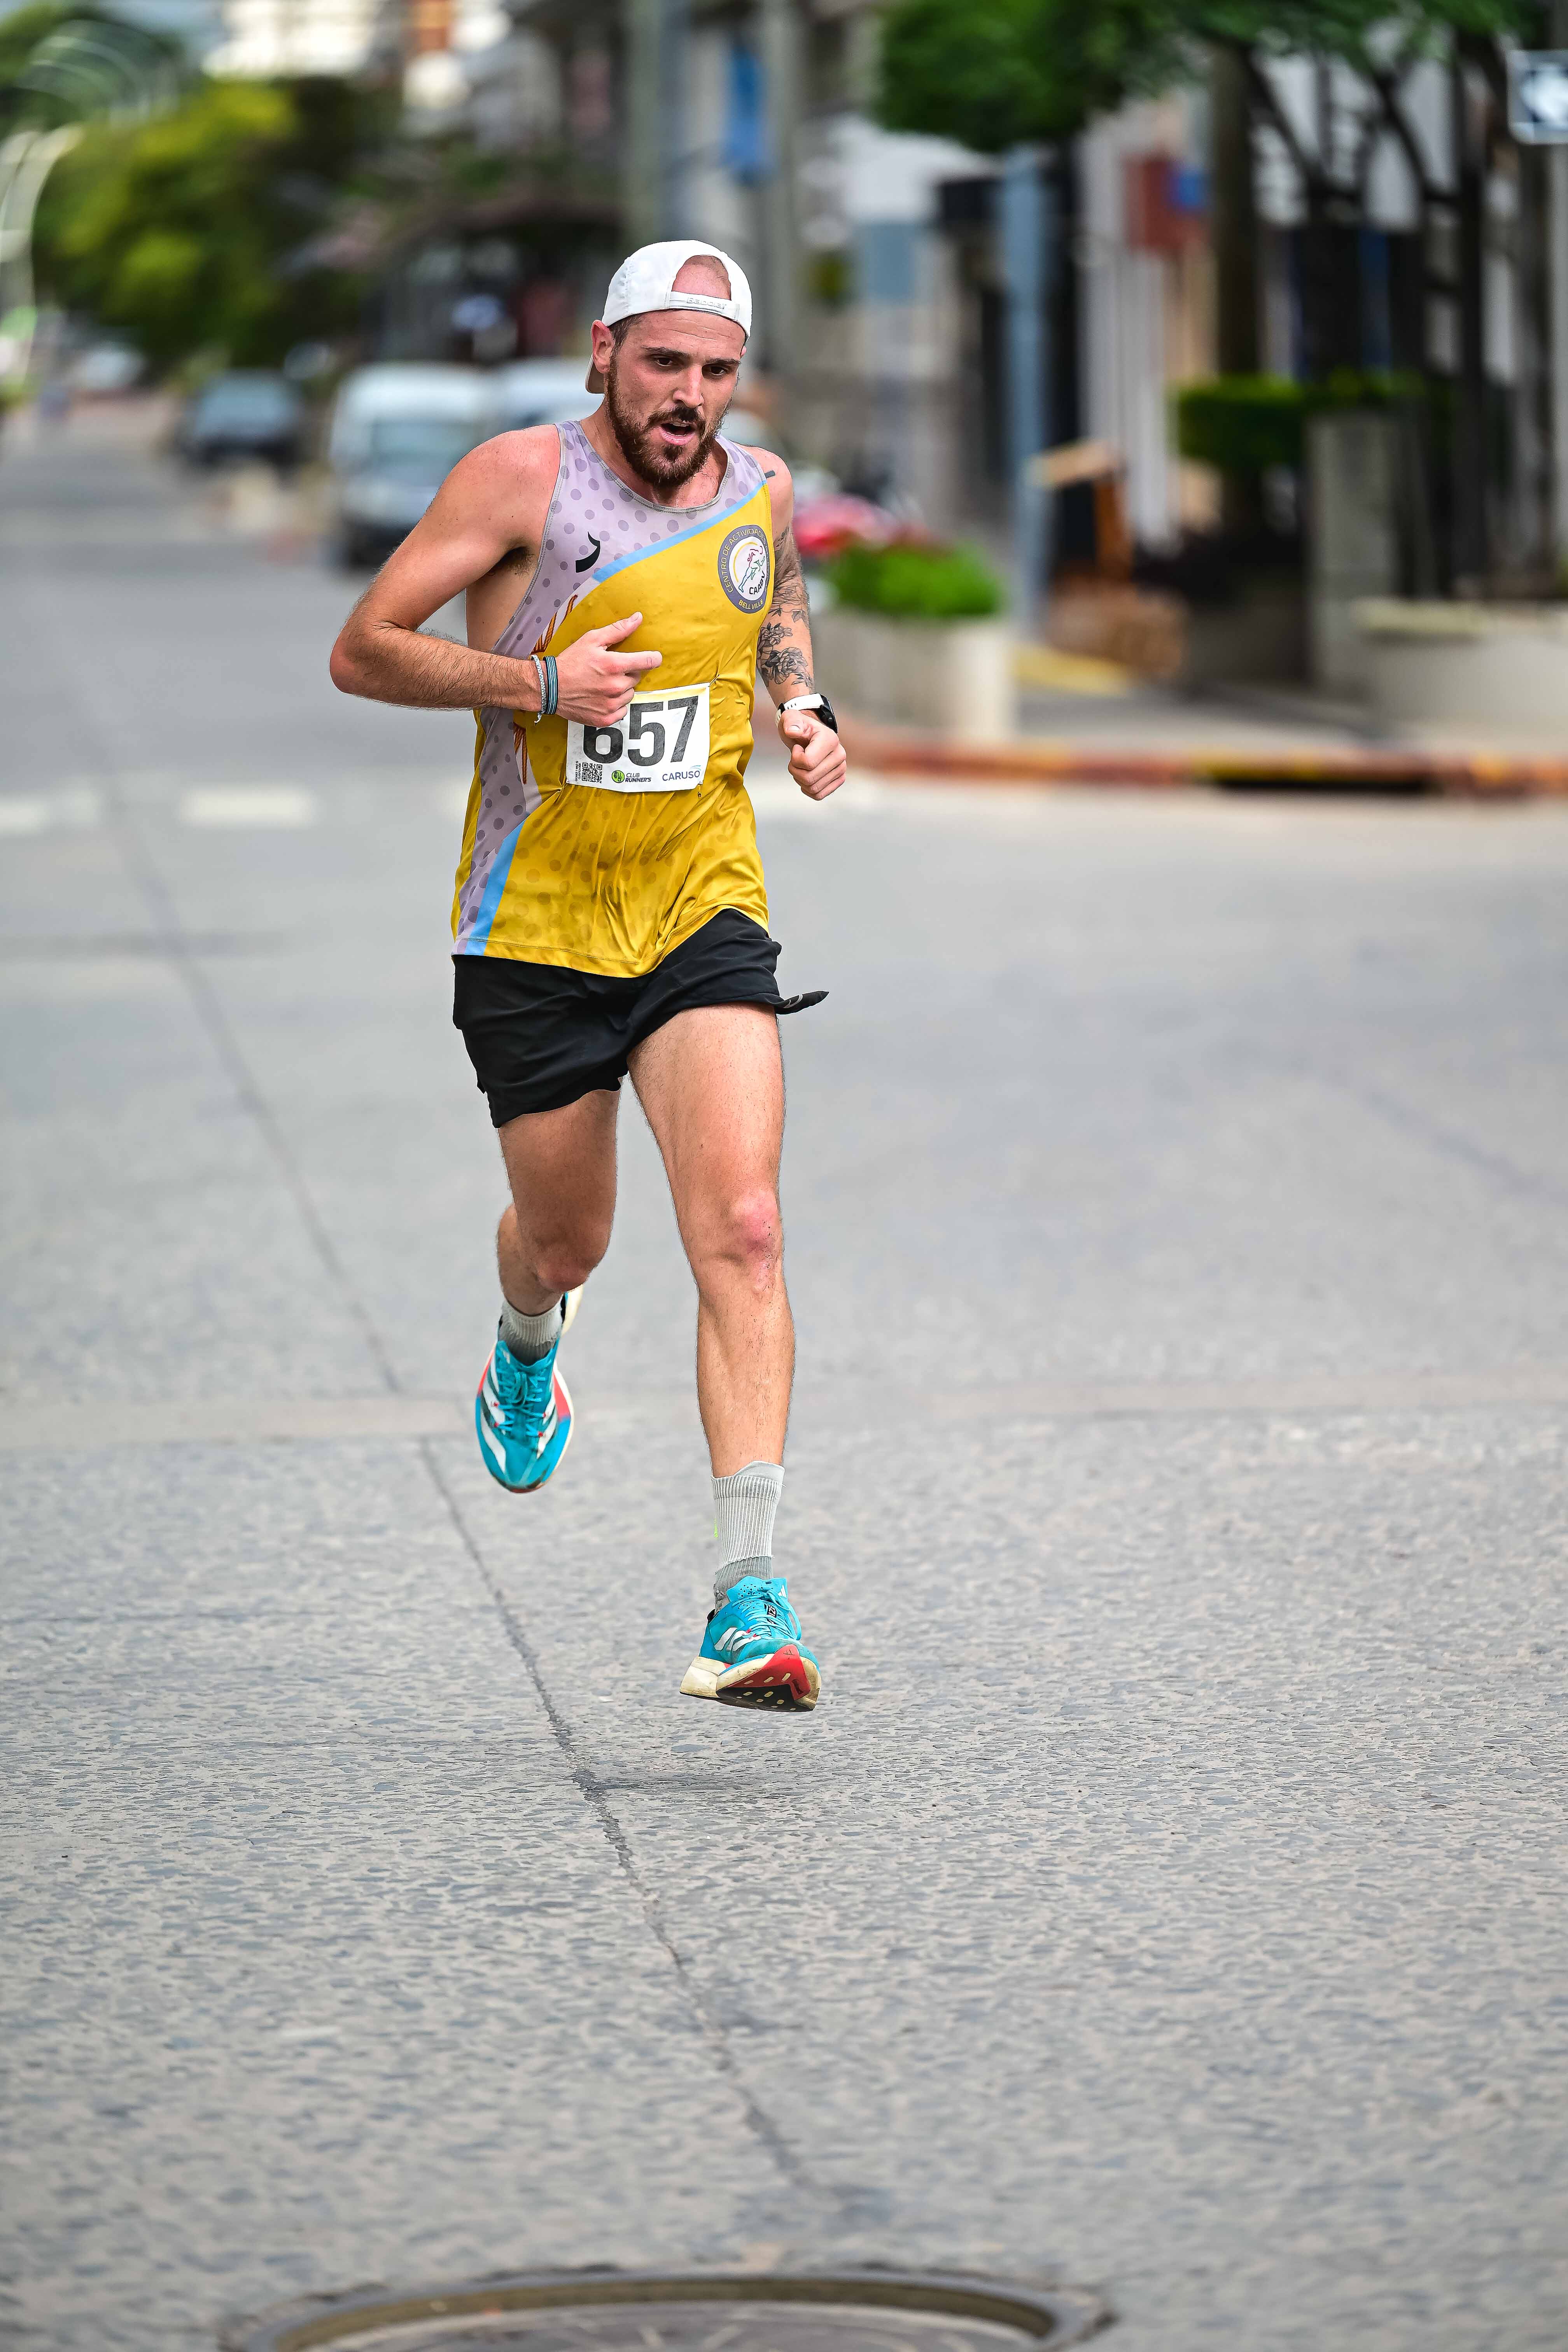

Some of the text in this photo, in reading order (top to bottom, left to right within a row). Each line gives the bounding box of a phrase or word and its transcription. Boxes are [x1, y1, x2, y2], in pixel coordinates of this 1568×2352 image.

[721, 528, 766, 593] CENTRO DE ACTIVIDADES
[749, 570, 765, 595] CAABV
[738, 598, 764, 610] BELL VILLE
[583, 695, 698, 766] 657
[662, 770, 700, 781] CARUSO
